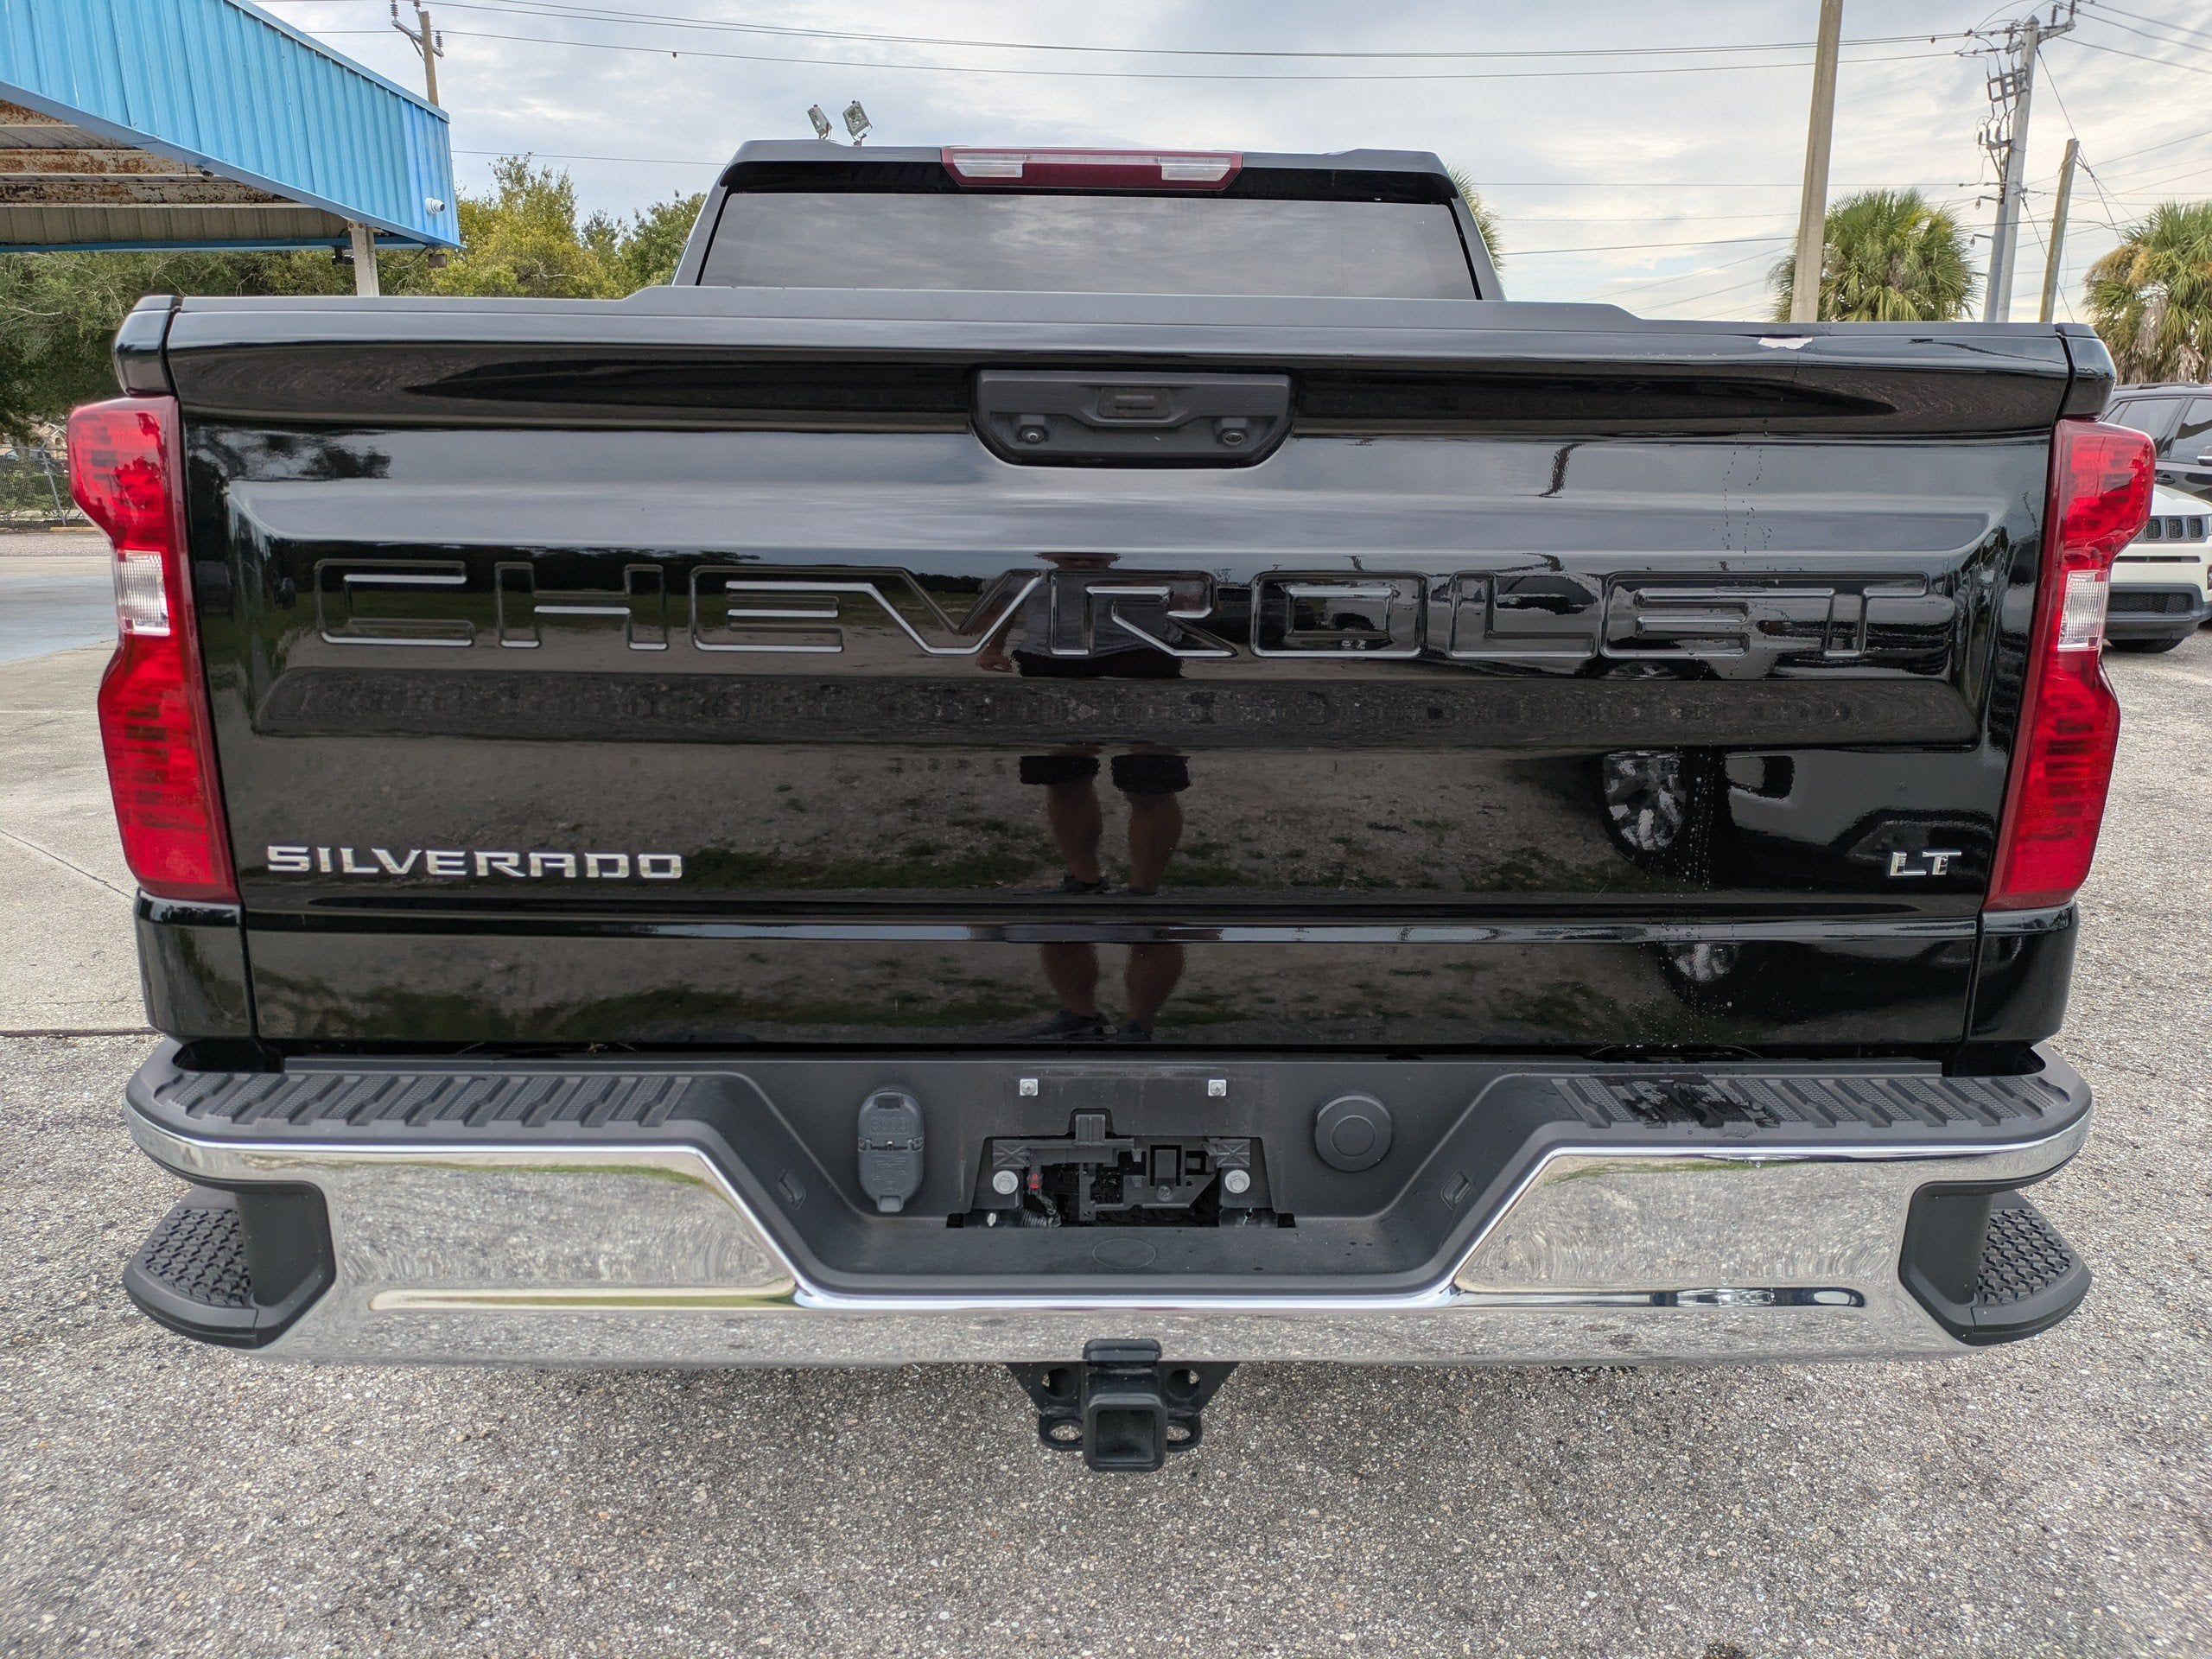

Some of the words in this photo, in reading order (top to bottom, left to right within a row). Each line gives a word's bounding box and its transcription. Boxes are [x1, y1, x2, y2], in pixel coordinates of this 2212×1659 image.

[315, 559, 1929, 658] CHEVROLET
[267, 845, 683, 880] SILVERADO
[1890, 851, 1962, 876] LT
